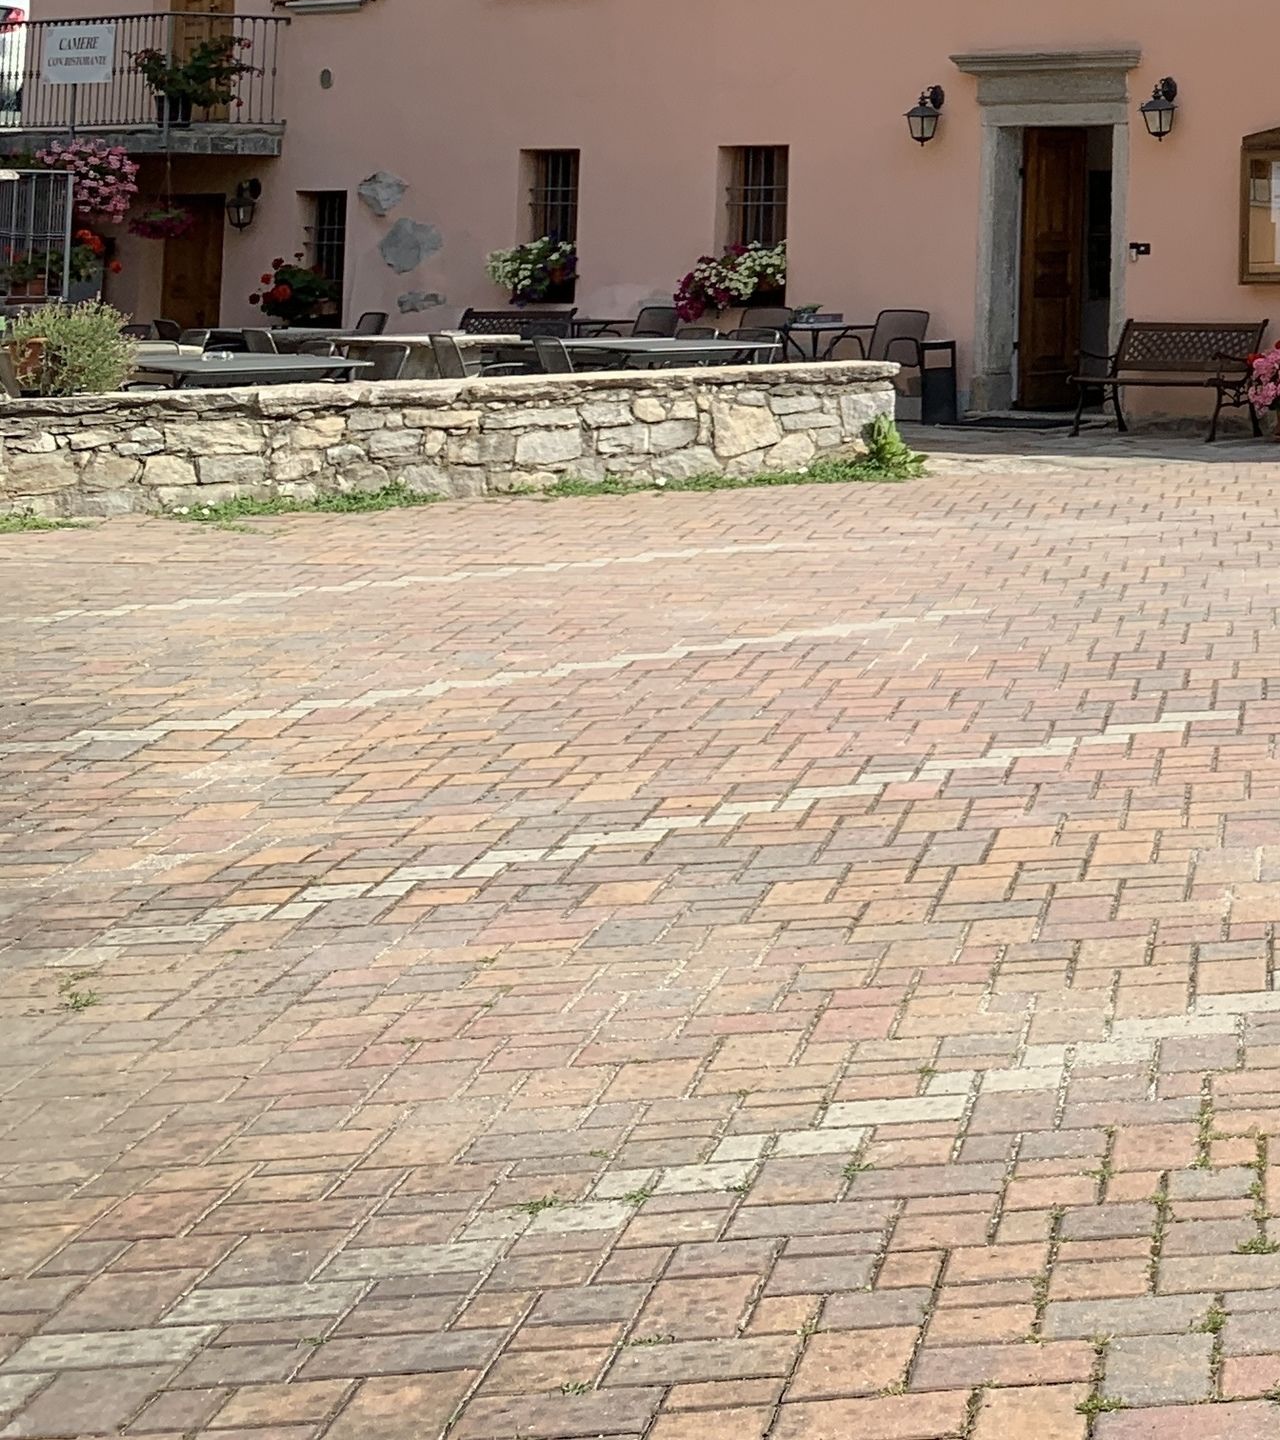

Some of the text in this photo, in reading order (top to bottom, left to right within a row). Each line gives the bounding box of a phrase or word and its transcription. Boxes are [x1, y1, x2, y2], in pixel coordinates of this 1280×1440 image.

[59, 36, 99, 50] CAMERE
[48, 56, 107, 67] CON RISTORANTE
